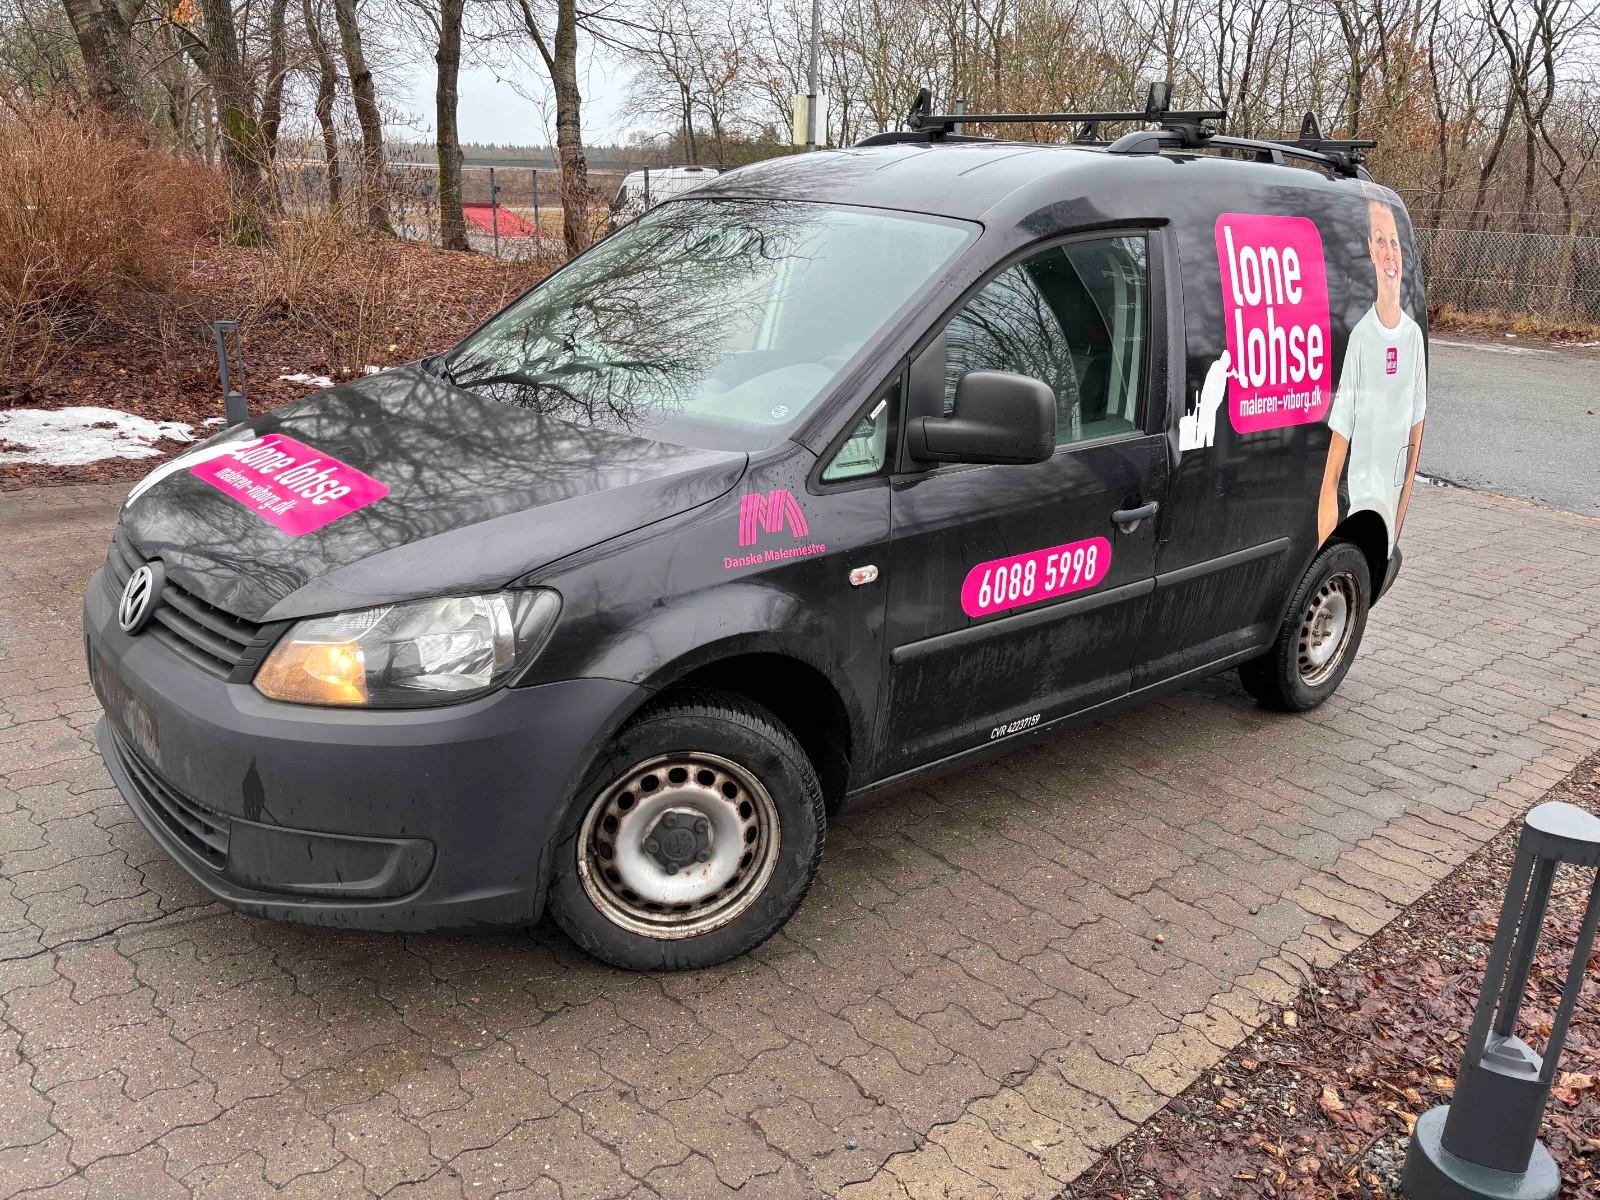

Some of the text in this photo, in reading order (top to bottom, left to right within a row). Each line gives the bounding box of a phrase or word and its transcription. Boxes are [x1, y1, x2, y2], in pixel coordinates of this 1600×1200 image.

[1224, 225, 1302, 306] lone
[1235, 307, 1324, 389] lohse
[1240, 385, 1322, 417] maleren-viborg.dk
[213, 467, 298, 516] maleren-viborg.dk
[233, 440, 351, 505] lone lohse
[724, 543, 826, 569] Danske Malermestre
[978, 545, 1098, 608] 6088 5998
[990, 713, 1041, 739] CVR 42237159
